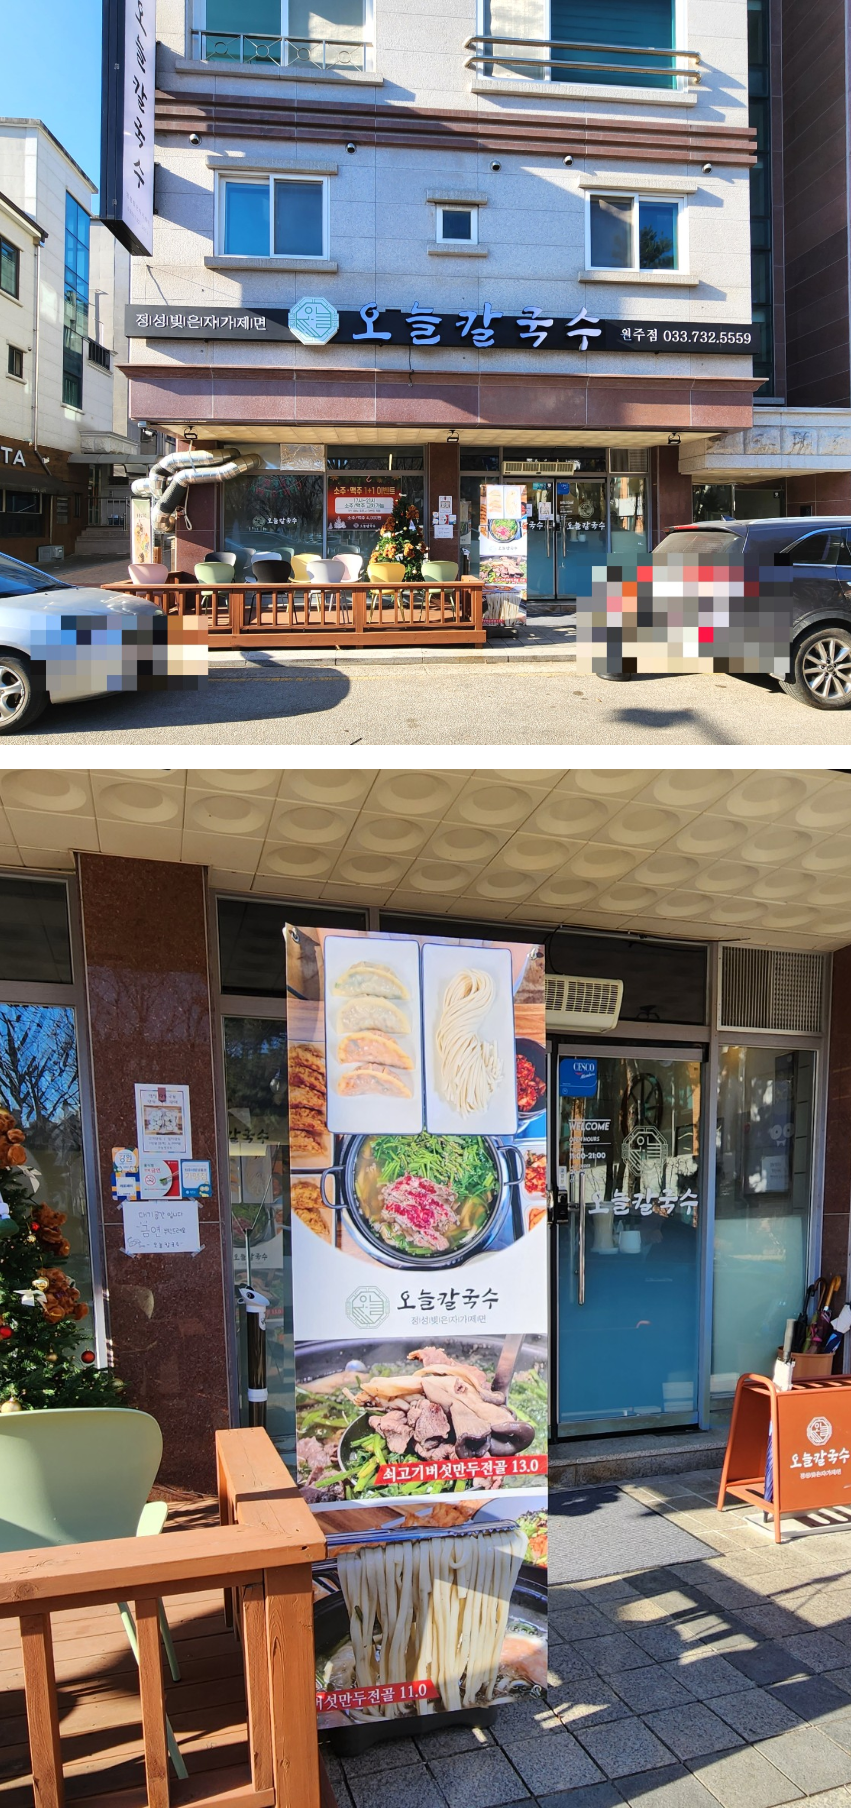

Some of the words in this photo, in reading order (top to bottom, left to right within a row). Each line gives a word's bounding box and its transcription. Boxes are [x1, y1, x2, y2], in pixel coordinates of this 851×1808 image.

[352, 301, 602, 351] 오늘칼국수
[620, 328, 658, 343] 원주점
[663, 330, 752, 345] 033.732.5559
[364, 486, 375, 495] 1+1
[376, 486, 396, 495] 이벤트
[566, 521, 606, 531] 오늘칼국수
[573, 1062, 595, 1072] CESCO
[569, 1122, 610, 1131] WELCOME
[588, 1188, 699, 1216] 오늘칼국수
[396, 1287, 500, 1311] 오늘칼국수
[790, 1447, 850, 1469] 오늘칼국수
[382, 1459, 508, 1482] 쇠고기버섯만두전골
[511, 1459, 539, 1473] 13.0
[400, 1683, 427, 1699] 11.0
